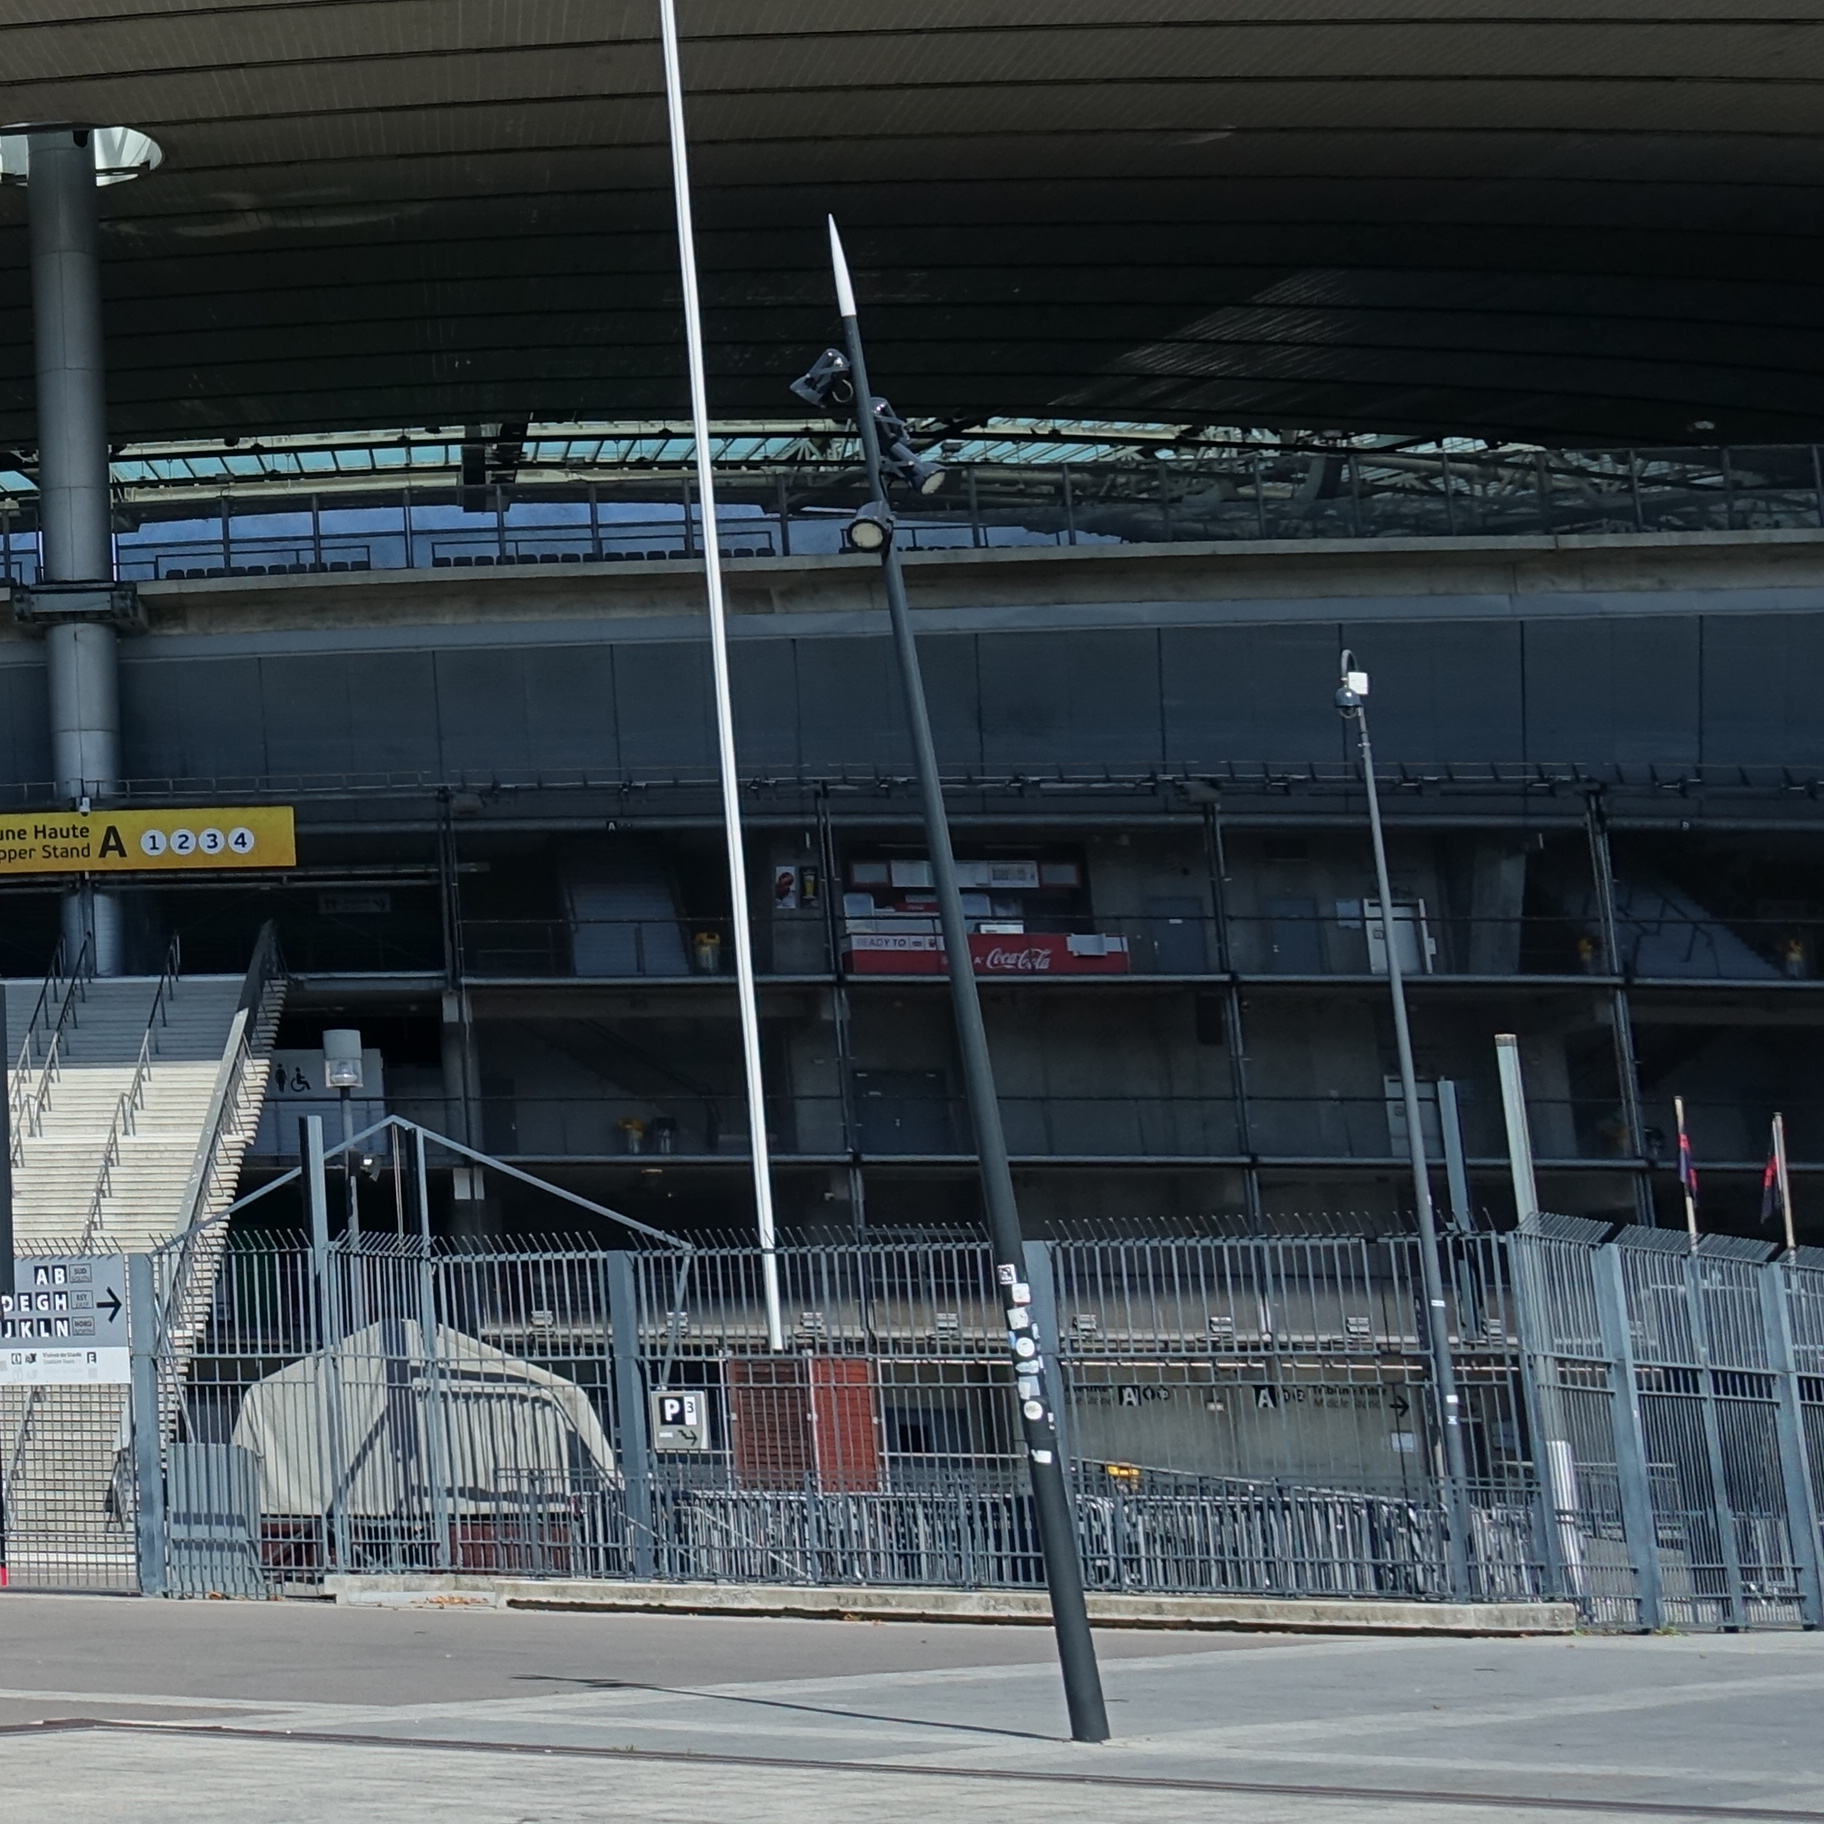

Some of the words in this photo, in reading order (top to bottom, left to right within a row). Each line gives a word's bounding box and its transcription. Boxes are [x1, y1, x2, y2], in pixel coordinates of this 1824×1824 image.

[34, 824, 90, 840] Haute
[98, 826, 128, 858] A
[41, 843, 91, 859] Stand
[36, 1268, 48, 1285] A
[54, 1268, 65, 1284] B
[665, 1398, 680, 1421] P
[687, 1401, 694, 1413] 3
